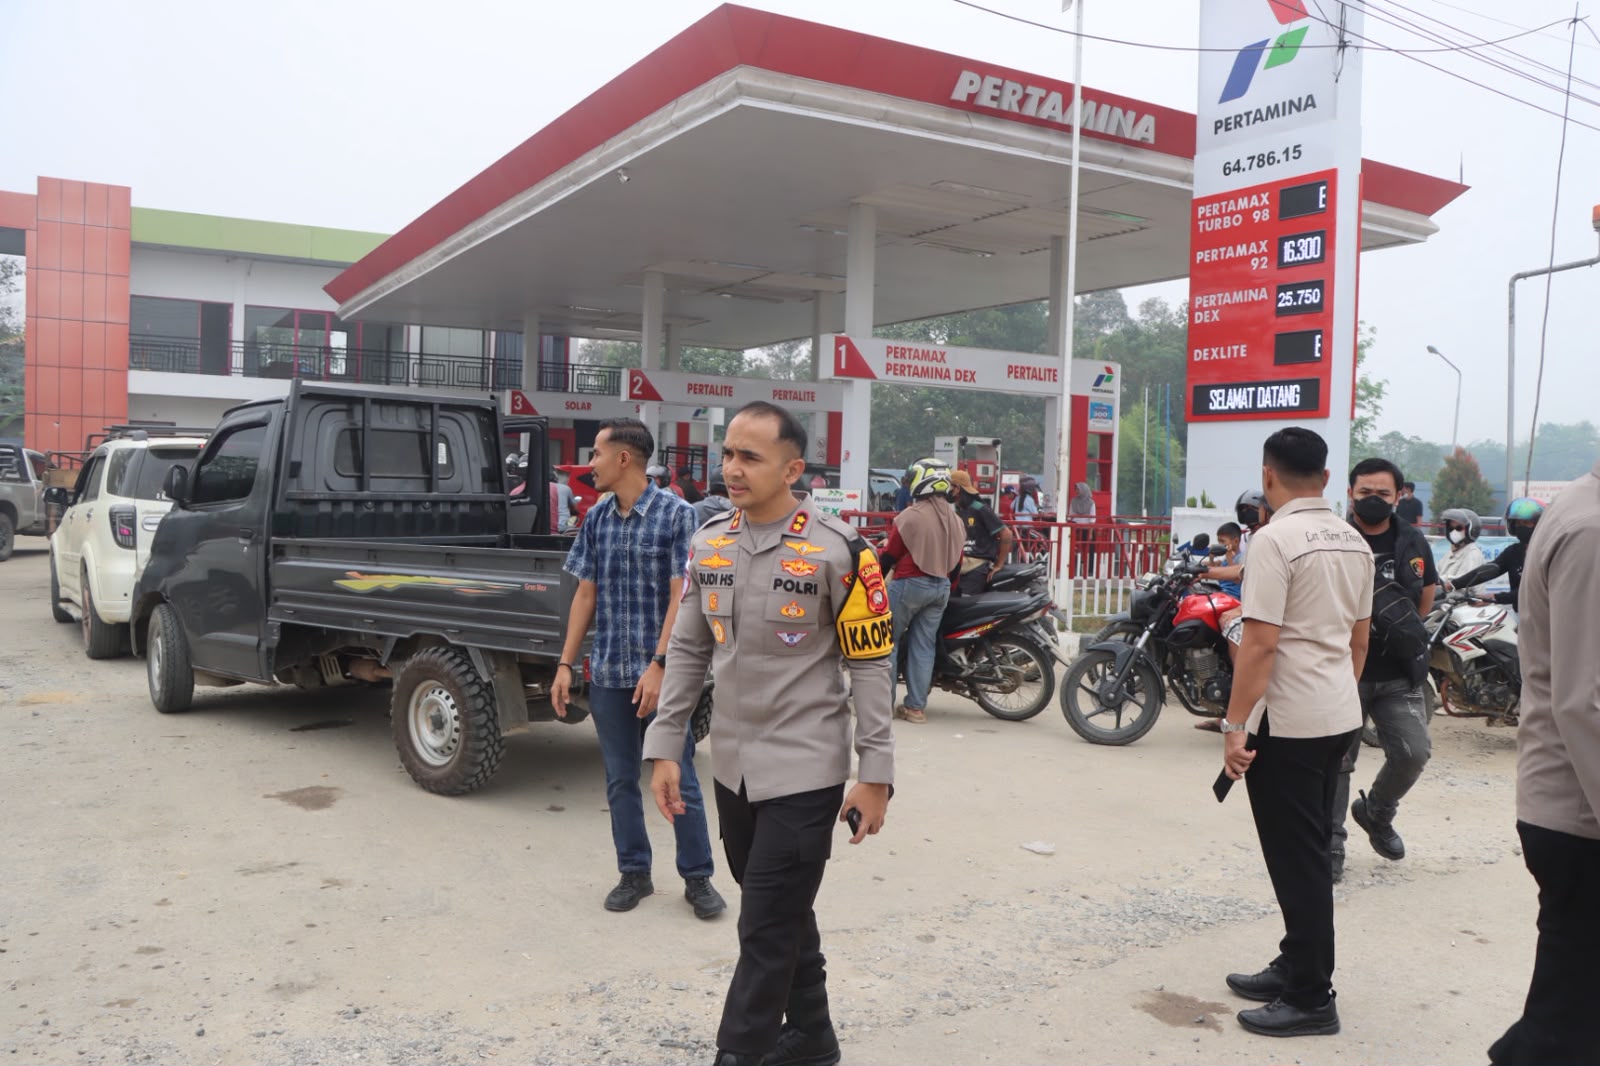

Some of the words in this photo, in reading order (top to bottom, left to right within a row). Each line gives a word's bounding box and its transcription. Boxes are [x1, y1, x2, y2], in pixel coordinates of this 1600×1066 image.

[951, 70, 1156, 144] PERTAMINA
[1214, 94, 1317, 135] PERTAMINA
[1222, 144, 1302, 176] 64.786.15
[1197, 192, 1270, 219] PERTAMAX
[1198, 213, 1243, 233] TURBO
[1252, 208, 1270, 224] 98
[1195, 239, 1269, 264] PERTAMAX
[1283, 236, 1321, 263] 16.300
[1250, 256, 1269, 271] 92
[1195, 287, 1269, 309] PERTAMINA
[1277, 288, 1321, 308] 25.750
[1194, 309, 1221, 324] DEX
[837, 344, 847, 370] 1
[886, 344, 947, 364] PERTAMAX
[1193, 344, 1248, 361] DEXLITE
[885, 362, 951, 381] PERTAMINA
[954, 368, 977, 384] DEX
[1007, 364, 1058, 383] PERTALITE
[632, 375, 643, 396] 2
[687, 382, 734, 398] PERTALITE
[514, 395, 522, 410] 3
[565, 400, 592, 412] SOLAR
[772, 389, 816, 403] PERTALITE
[1208, 387, 1255, 411] SELAMAT
[1256, 384, 1301, 408] DATANG
[720, 573, 734, 587] HS
[773, 578, 818, 596] POLRI
